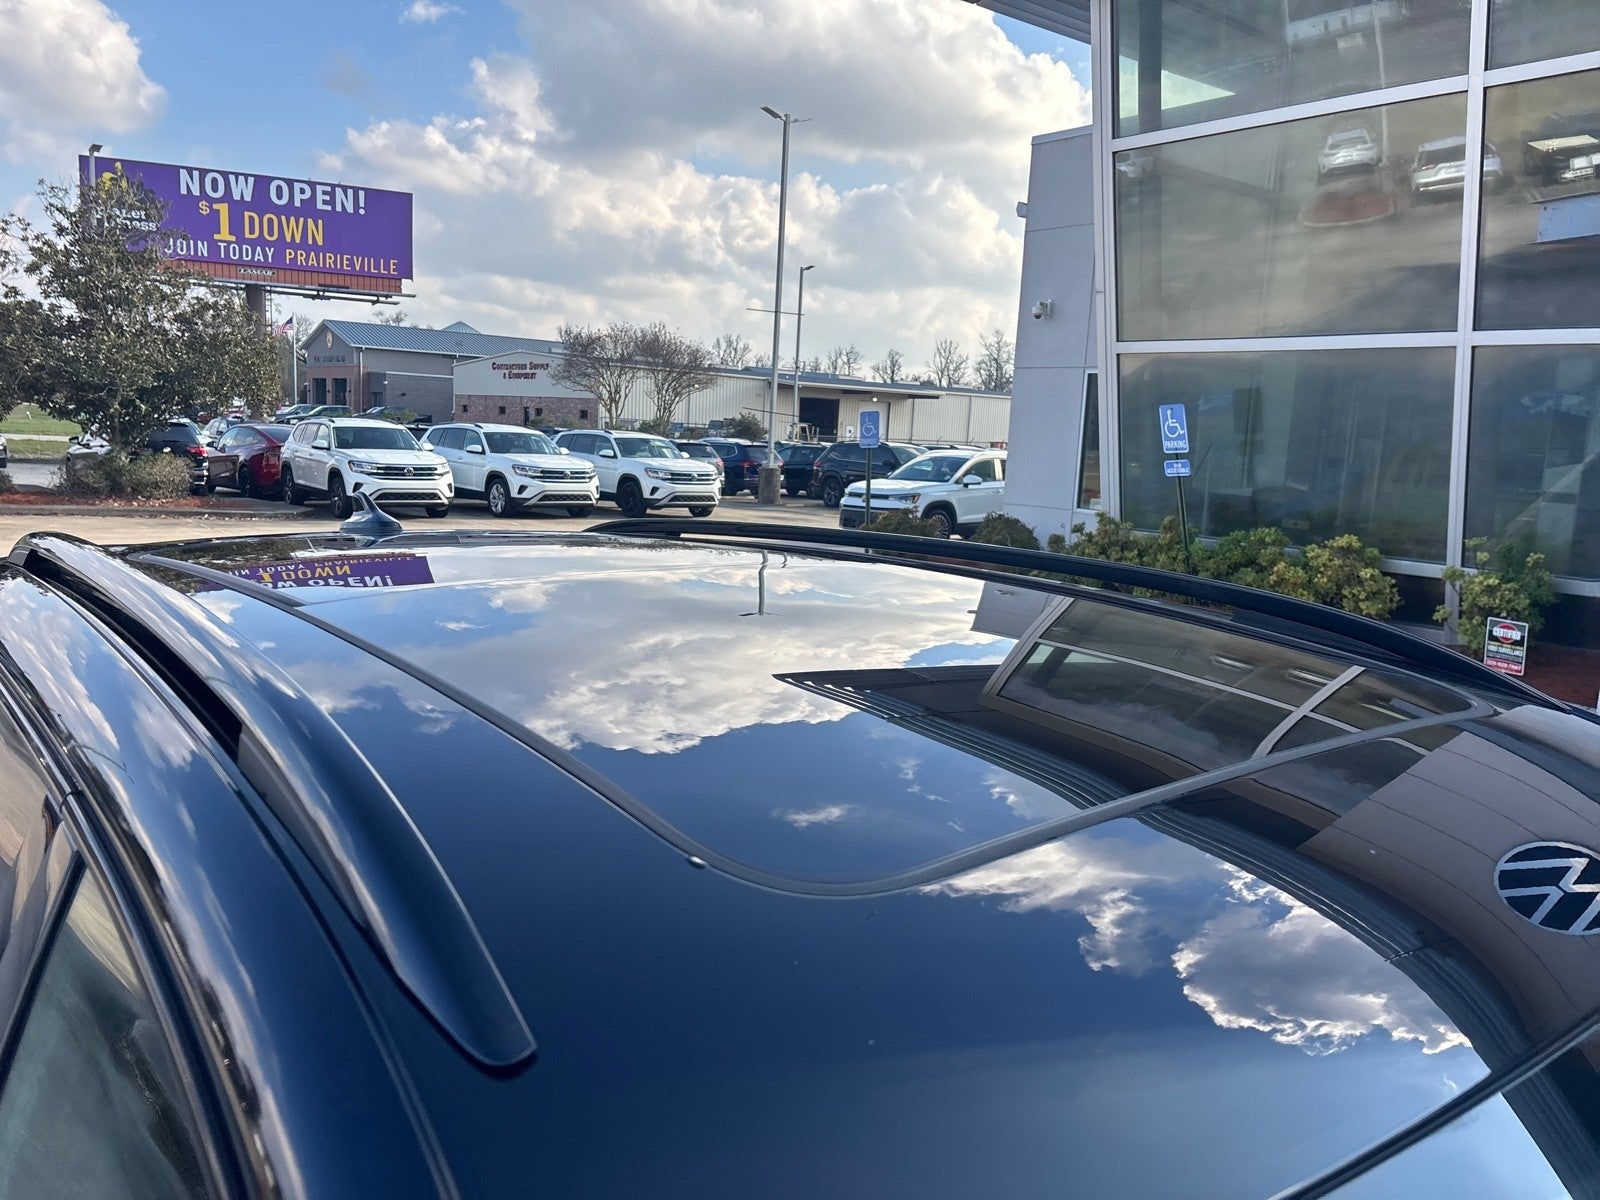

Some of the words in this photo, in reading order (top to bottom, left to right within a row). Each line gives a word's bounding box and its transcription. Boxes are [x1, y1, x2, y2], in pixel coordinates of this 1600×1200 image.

[179, 168, 255, 202] NOW
[269, 179, 367, 215] OPEN!
[244, 211, 324, 246] DOWN
[164, 237, 208, 257] JOIN
[218, 241, 275, 263] TODAY
[285, 248, 399, 275] PRAIRIEVILLE
[240, 268, 273, 276] LAMAR
[1164, 440, 1186, 448] PARKING
